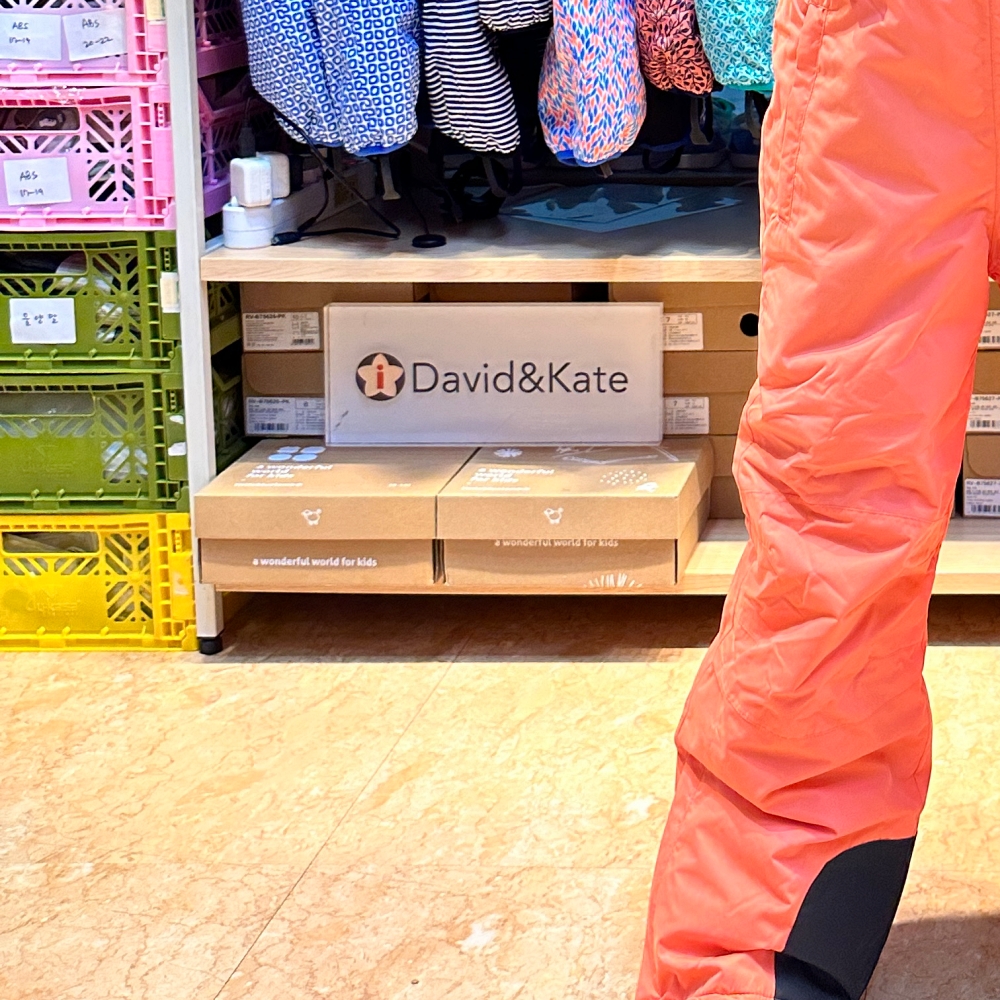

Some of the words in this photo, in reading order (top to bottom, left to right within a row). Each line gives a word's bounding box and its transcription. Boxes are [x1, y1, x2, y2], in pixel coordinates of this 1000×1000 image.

[412, 359, 629, 394] David&Kate
[502, 539, 553, 547] wonderful
[554, 539, 582, 547] world
[598, 539, 619, 547] kids
[252, 558, 259, 566] a
[260, 556, 311, 566] wonderful
[311, 557, 340, 567] world
[341, 556, 356, 567] for
[357, 557, 378, 567] kids
